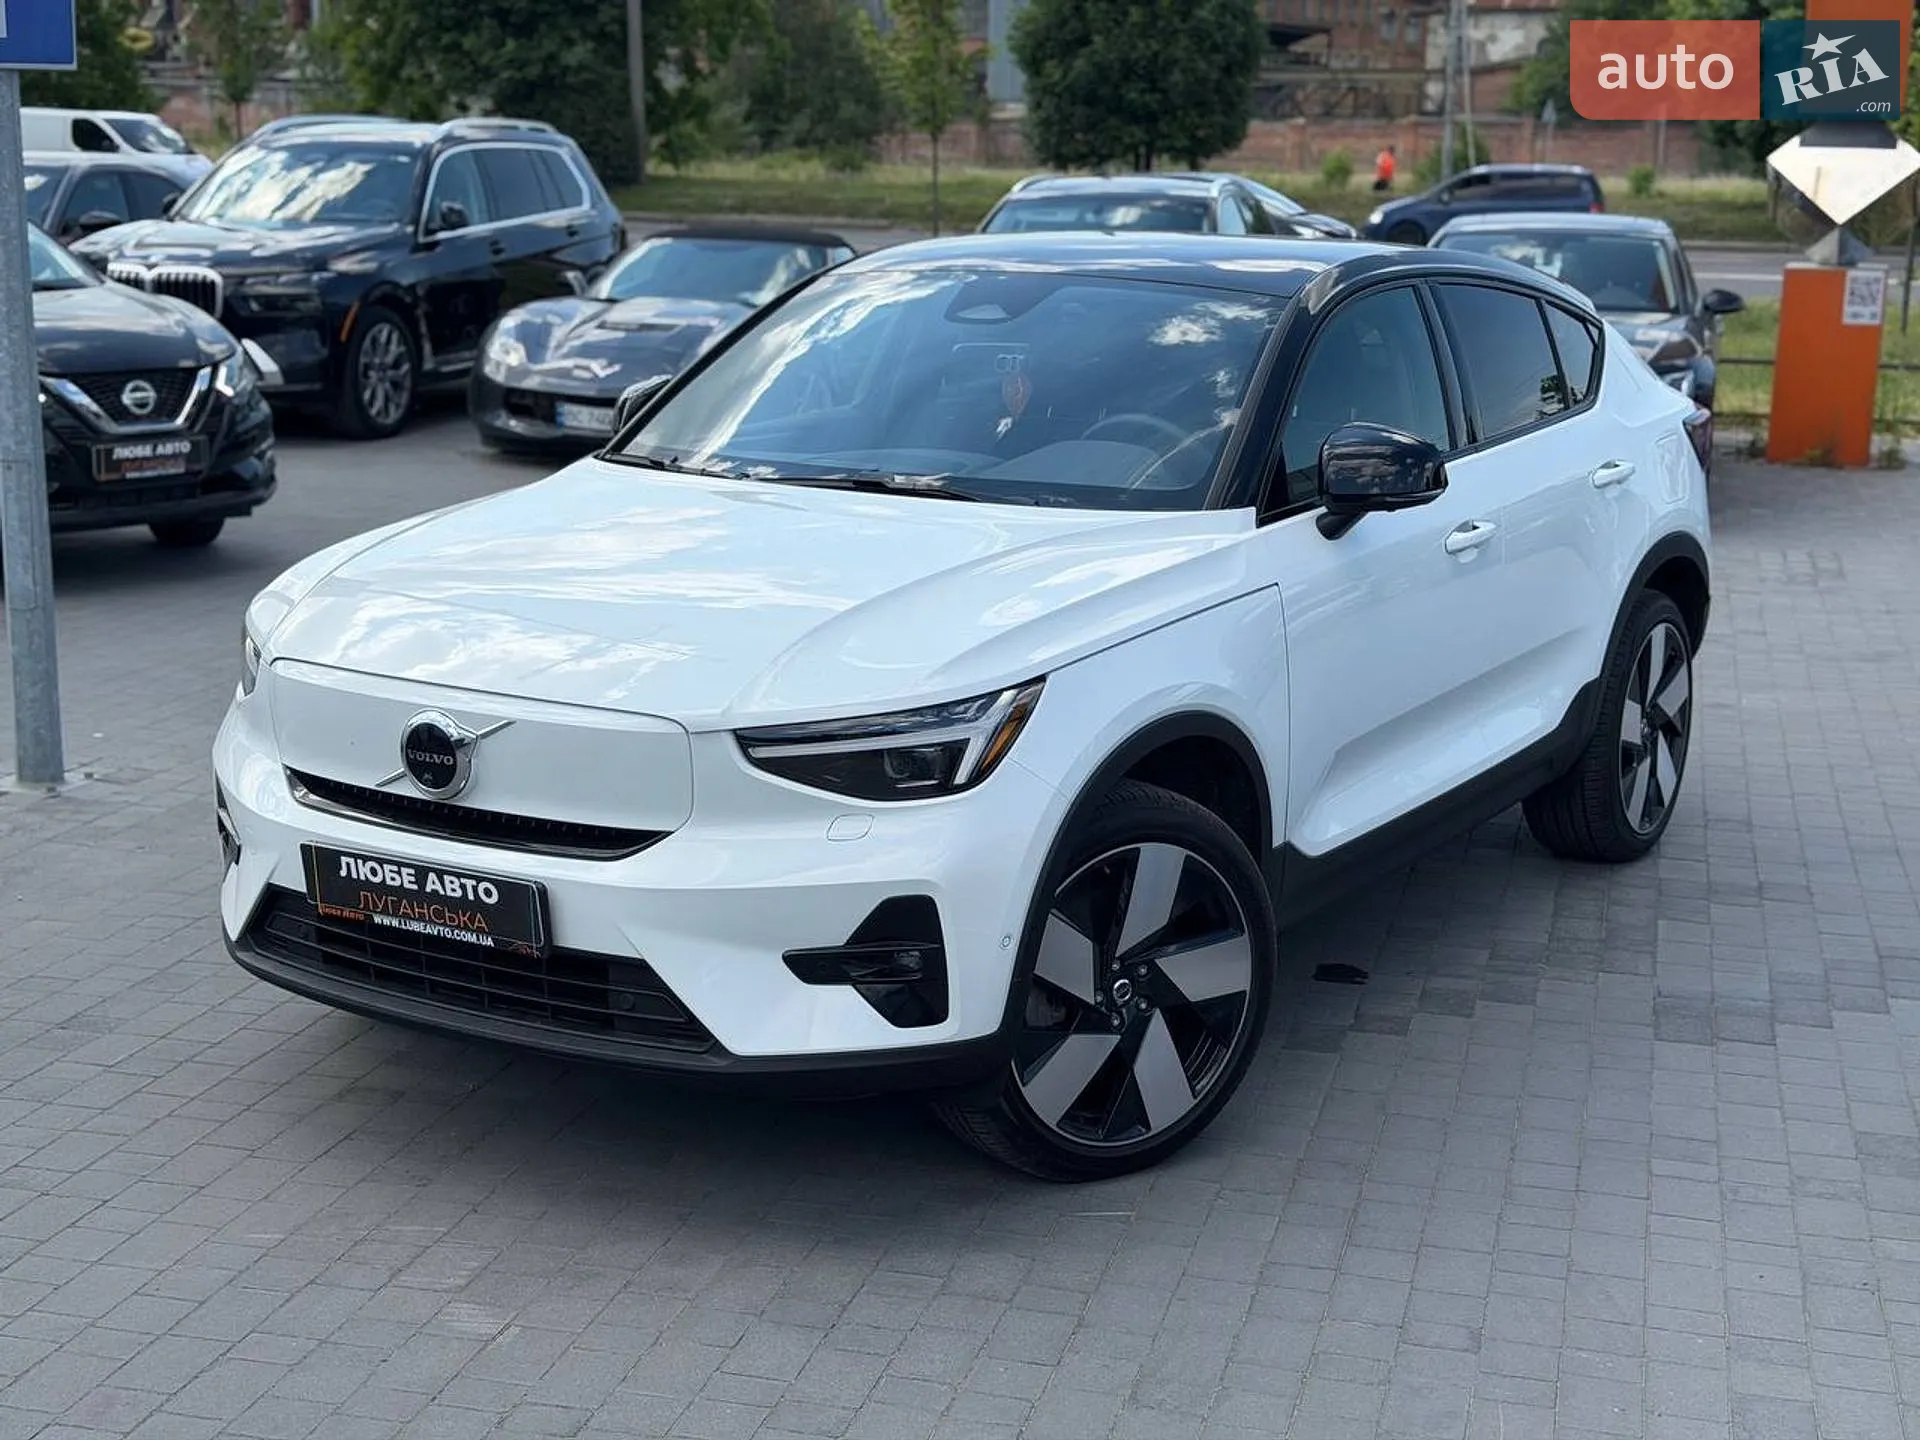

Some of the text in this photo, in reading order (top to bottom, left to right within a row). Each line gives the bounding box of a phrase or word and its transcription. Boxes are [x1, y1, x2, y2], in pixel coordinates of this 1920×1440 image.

[155, 441, 191, 457] АВТО
[406, 748, 454, 766] VOLVO
[339, 856, 500, 905] ЛЮБЕ АВТО
[359, 891, 489, 932] ЛУГАНСЬКА
[372, 913, 495, 948] WWW.LUBEAVTO.COM.UA
